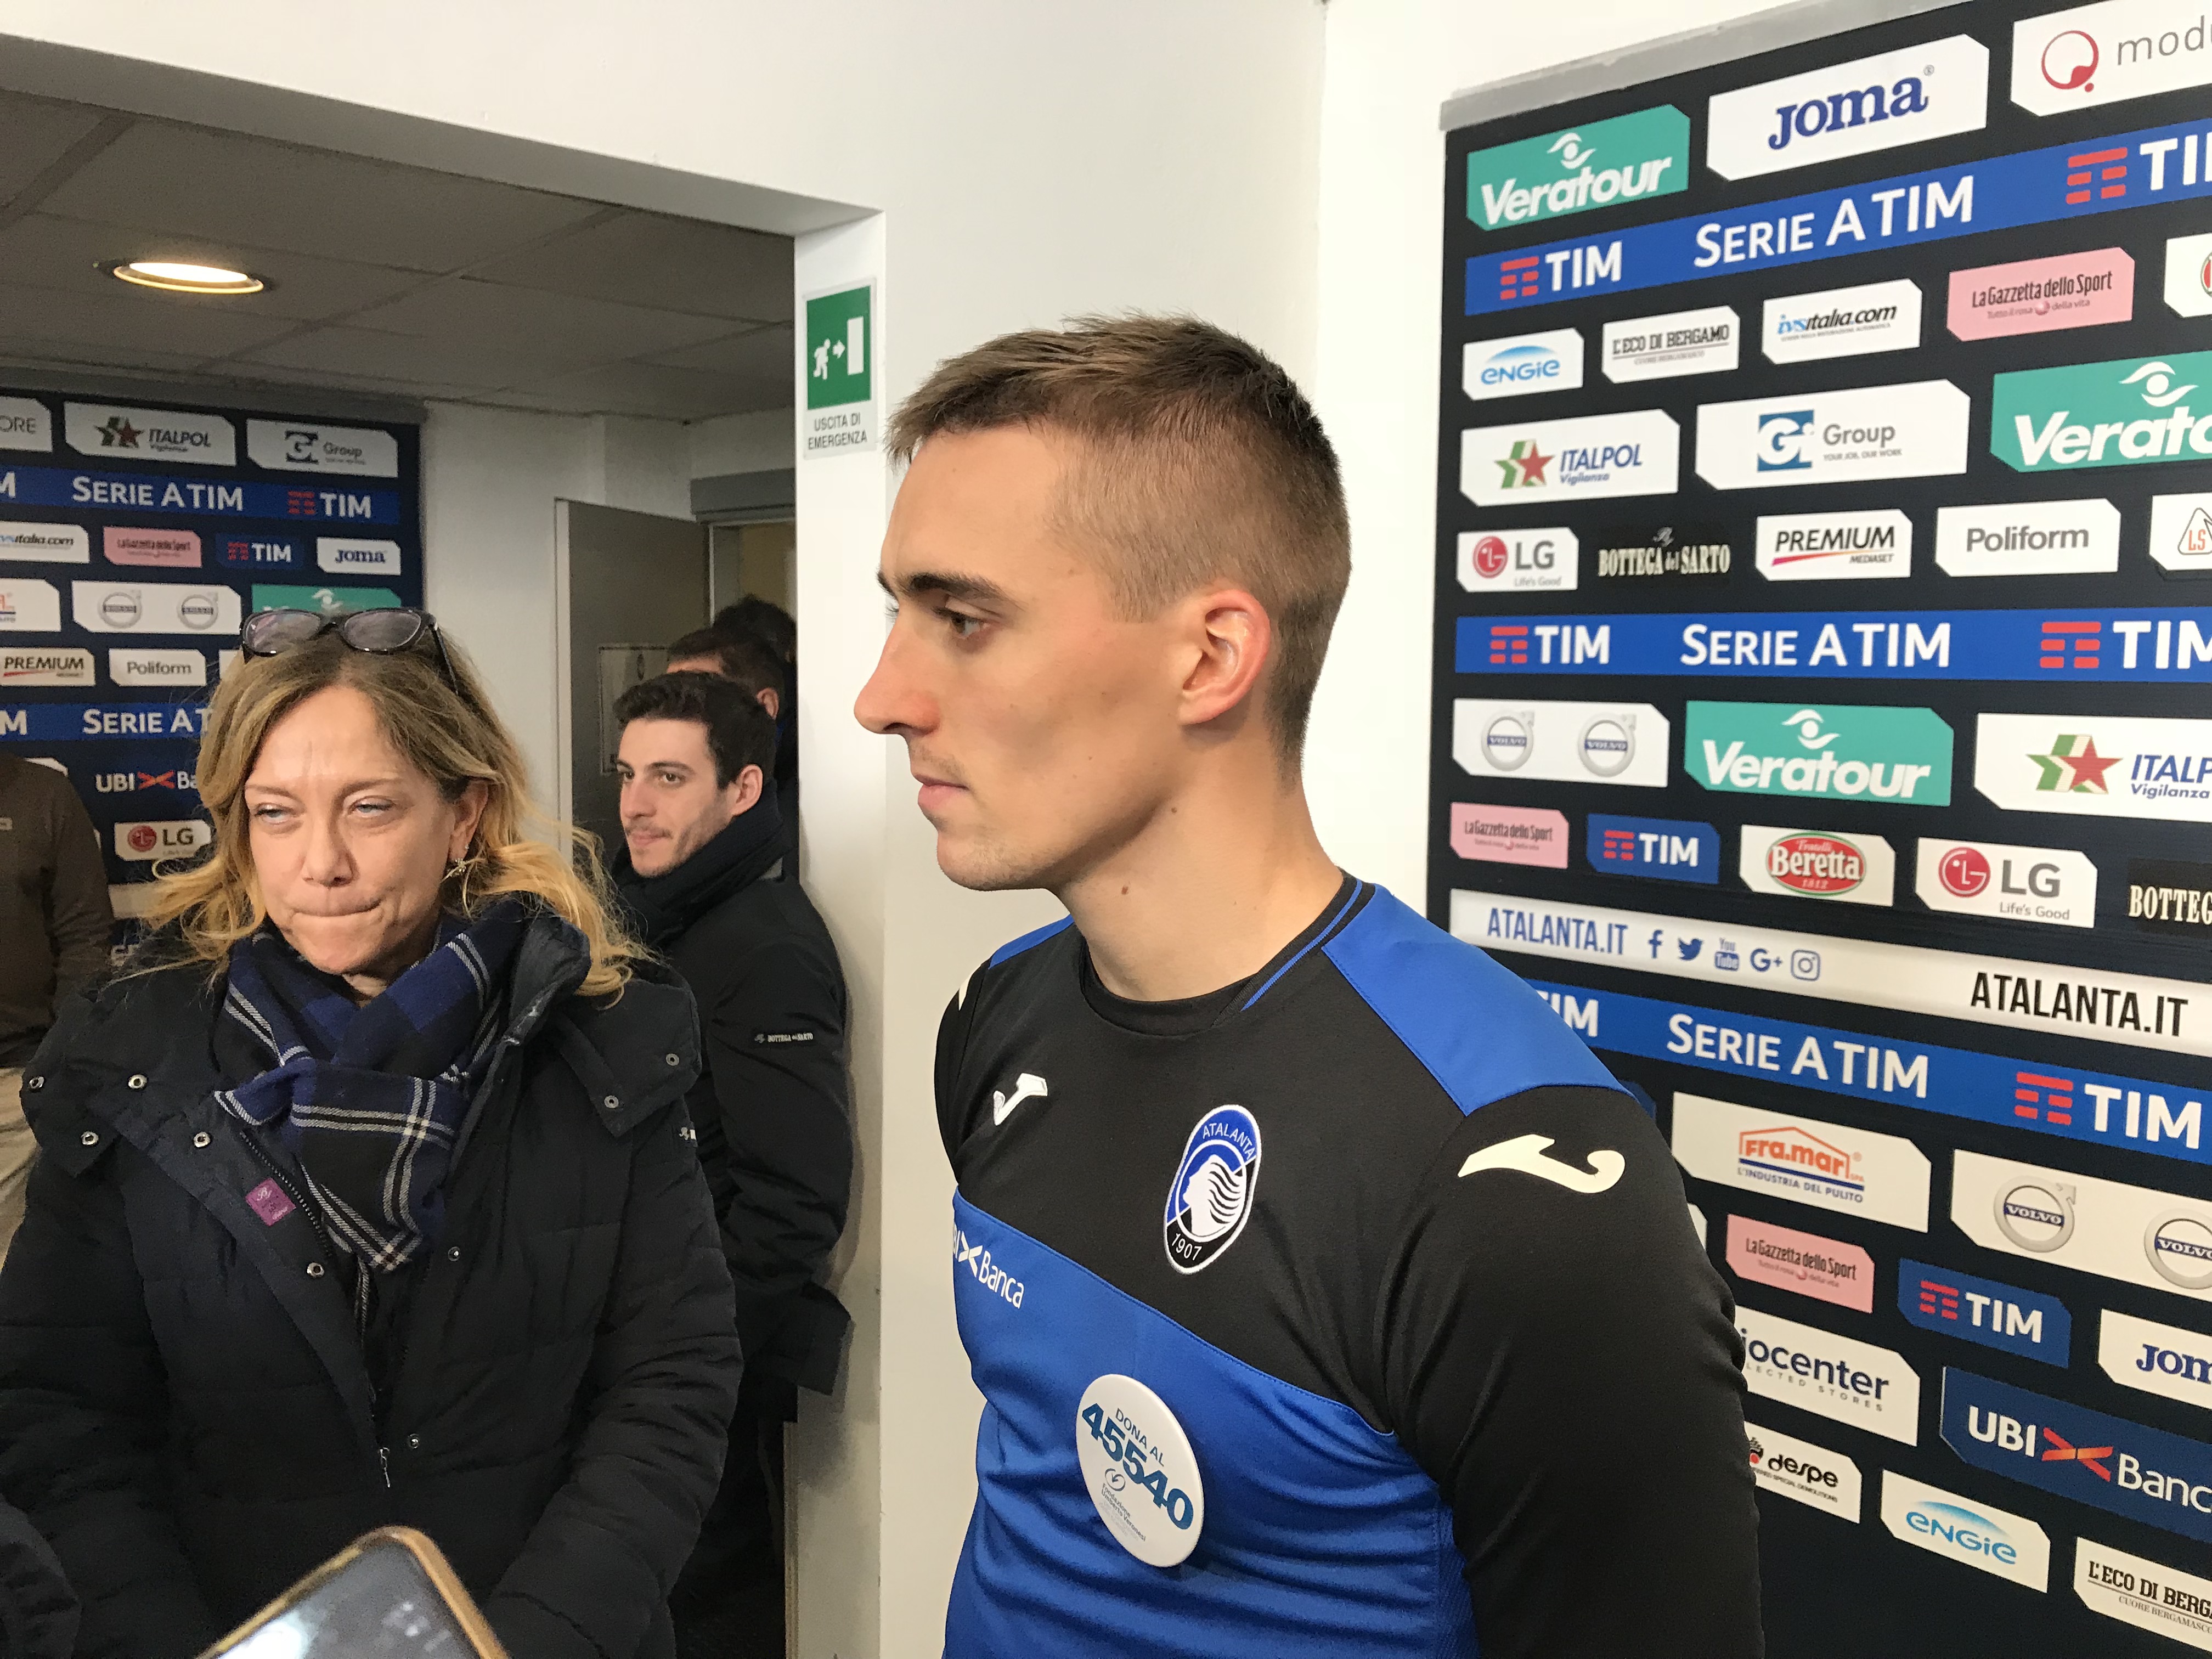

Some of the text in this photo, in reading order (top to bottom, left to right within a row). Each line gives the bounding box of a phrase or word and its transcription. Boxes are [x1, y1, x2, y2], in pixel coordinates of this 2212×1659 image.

[2118, 15, 2212, 66] mod
[2140, 133, 2212, 191] TI
[1481, 157, 1672, 225] Veratour
[1694, 174, 1974, 268] SERIE A TIM
[1545, 240, 1623, 292] TIM
[1988, 281, 2041, 306] Gazzetta
[2044, 276, 2074, 297] dello
[2076, 270, 2113, 296] Sport
[1666, 324, 1730, 347] BERGAMO
[149, 428, 212, 448] ITALPOL
[813, 411, 862, 432] USCITA DI
[1822, 424, 1896, 448] Group
[323, 441, 363, 459] Group
[807, 429, 868, 451] EMERGENZA
[1560, 443, 1643, 472] ITALPOL
[72, 475, 243, 511] SERIE A TIM
[319, 492, 372, 519] TIM
[251, 542, 291, 563] TIM
[1515, 540, 1555, 570] LG
[1775, 525, 1895, 553] PREMIUM
[1966, 524, 2089, 554] Poliform
[1598, 546, 1664, 577] BOTTEGA
[1680, 544, 1731, 575] SARTO
[1534, 624, 1610, 665] TIM
[1679, 622, 1951, 668] SERIE A TIM
[2112, 620, 2212, 670] TIM
[4, 655, 84, 671] PREMIUM
[126, 661, 192, 676] Poliform
[82, 707, 163, 735] SERIE
[170, 708, 194, 733] A
[95, 771, 136, 793] UBI
[1702, 738, 1932, 799] Veratour
[2130, 783, 2210, 799] Vigilanza
[162, 827, 194, 846] LG
[1639, 832, 1700, 868] TIM
[1770, 845, 1861, 881] Beretta
[2000, 859, 2061, 898] LG
[1999, 901, 2070, 921] Life's Good
[2128, 884, 2212, 926] BOTTEG
[1487, 906, 1628, 955] ATALANTA.IT
[1536, 990, 1599, 1037] IM
[1970, 970, 2188, 1037] ATALANTA.IT
[1666, 1013, 1929, 1099] SERIE A TIM
[2084, 1082, 2202, 1150] TIM
[1203, 1122, 1256, 1160] ATALANTA
[1737, 1166, 1864, 1204] L'INDUSTRIA DEL PULITO
[2007, 1204, 2062, 1226] VOLVO
[1171, 1232, 1203, 1261] 1907
[1758, 1239, 1801, 1266] Gazzetta
[1802, 1251, 1827, 1272] dello
[1827, 1257, 1857, 1281] Sport
[978, 1250, 1025, 1310] Banca
[1965, 1292, 2044, 1344] TIM
[1818, 1385, 1883, 1413] STORES
[1115, 1407, 1165, 1468] DONA AL
[1081, 1402, 1194, 1531] 45540
[1767, 1453, 1839, 1488] despe
[1967, 1404, 2212, 1514] UBI Banc
[1101, 1488, 1123, 1517] Umberto
[1123, 1513, 1147, 1542] Veronesi
[1102, 1482, 1131, 1519] Fondazione
[2118, 1595, 2152, 1614] CUORE
[2138, 1578, 2159, 1601] DI
[2163, 1586, 2212, 1620] BERG
